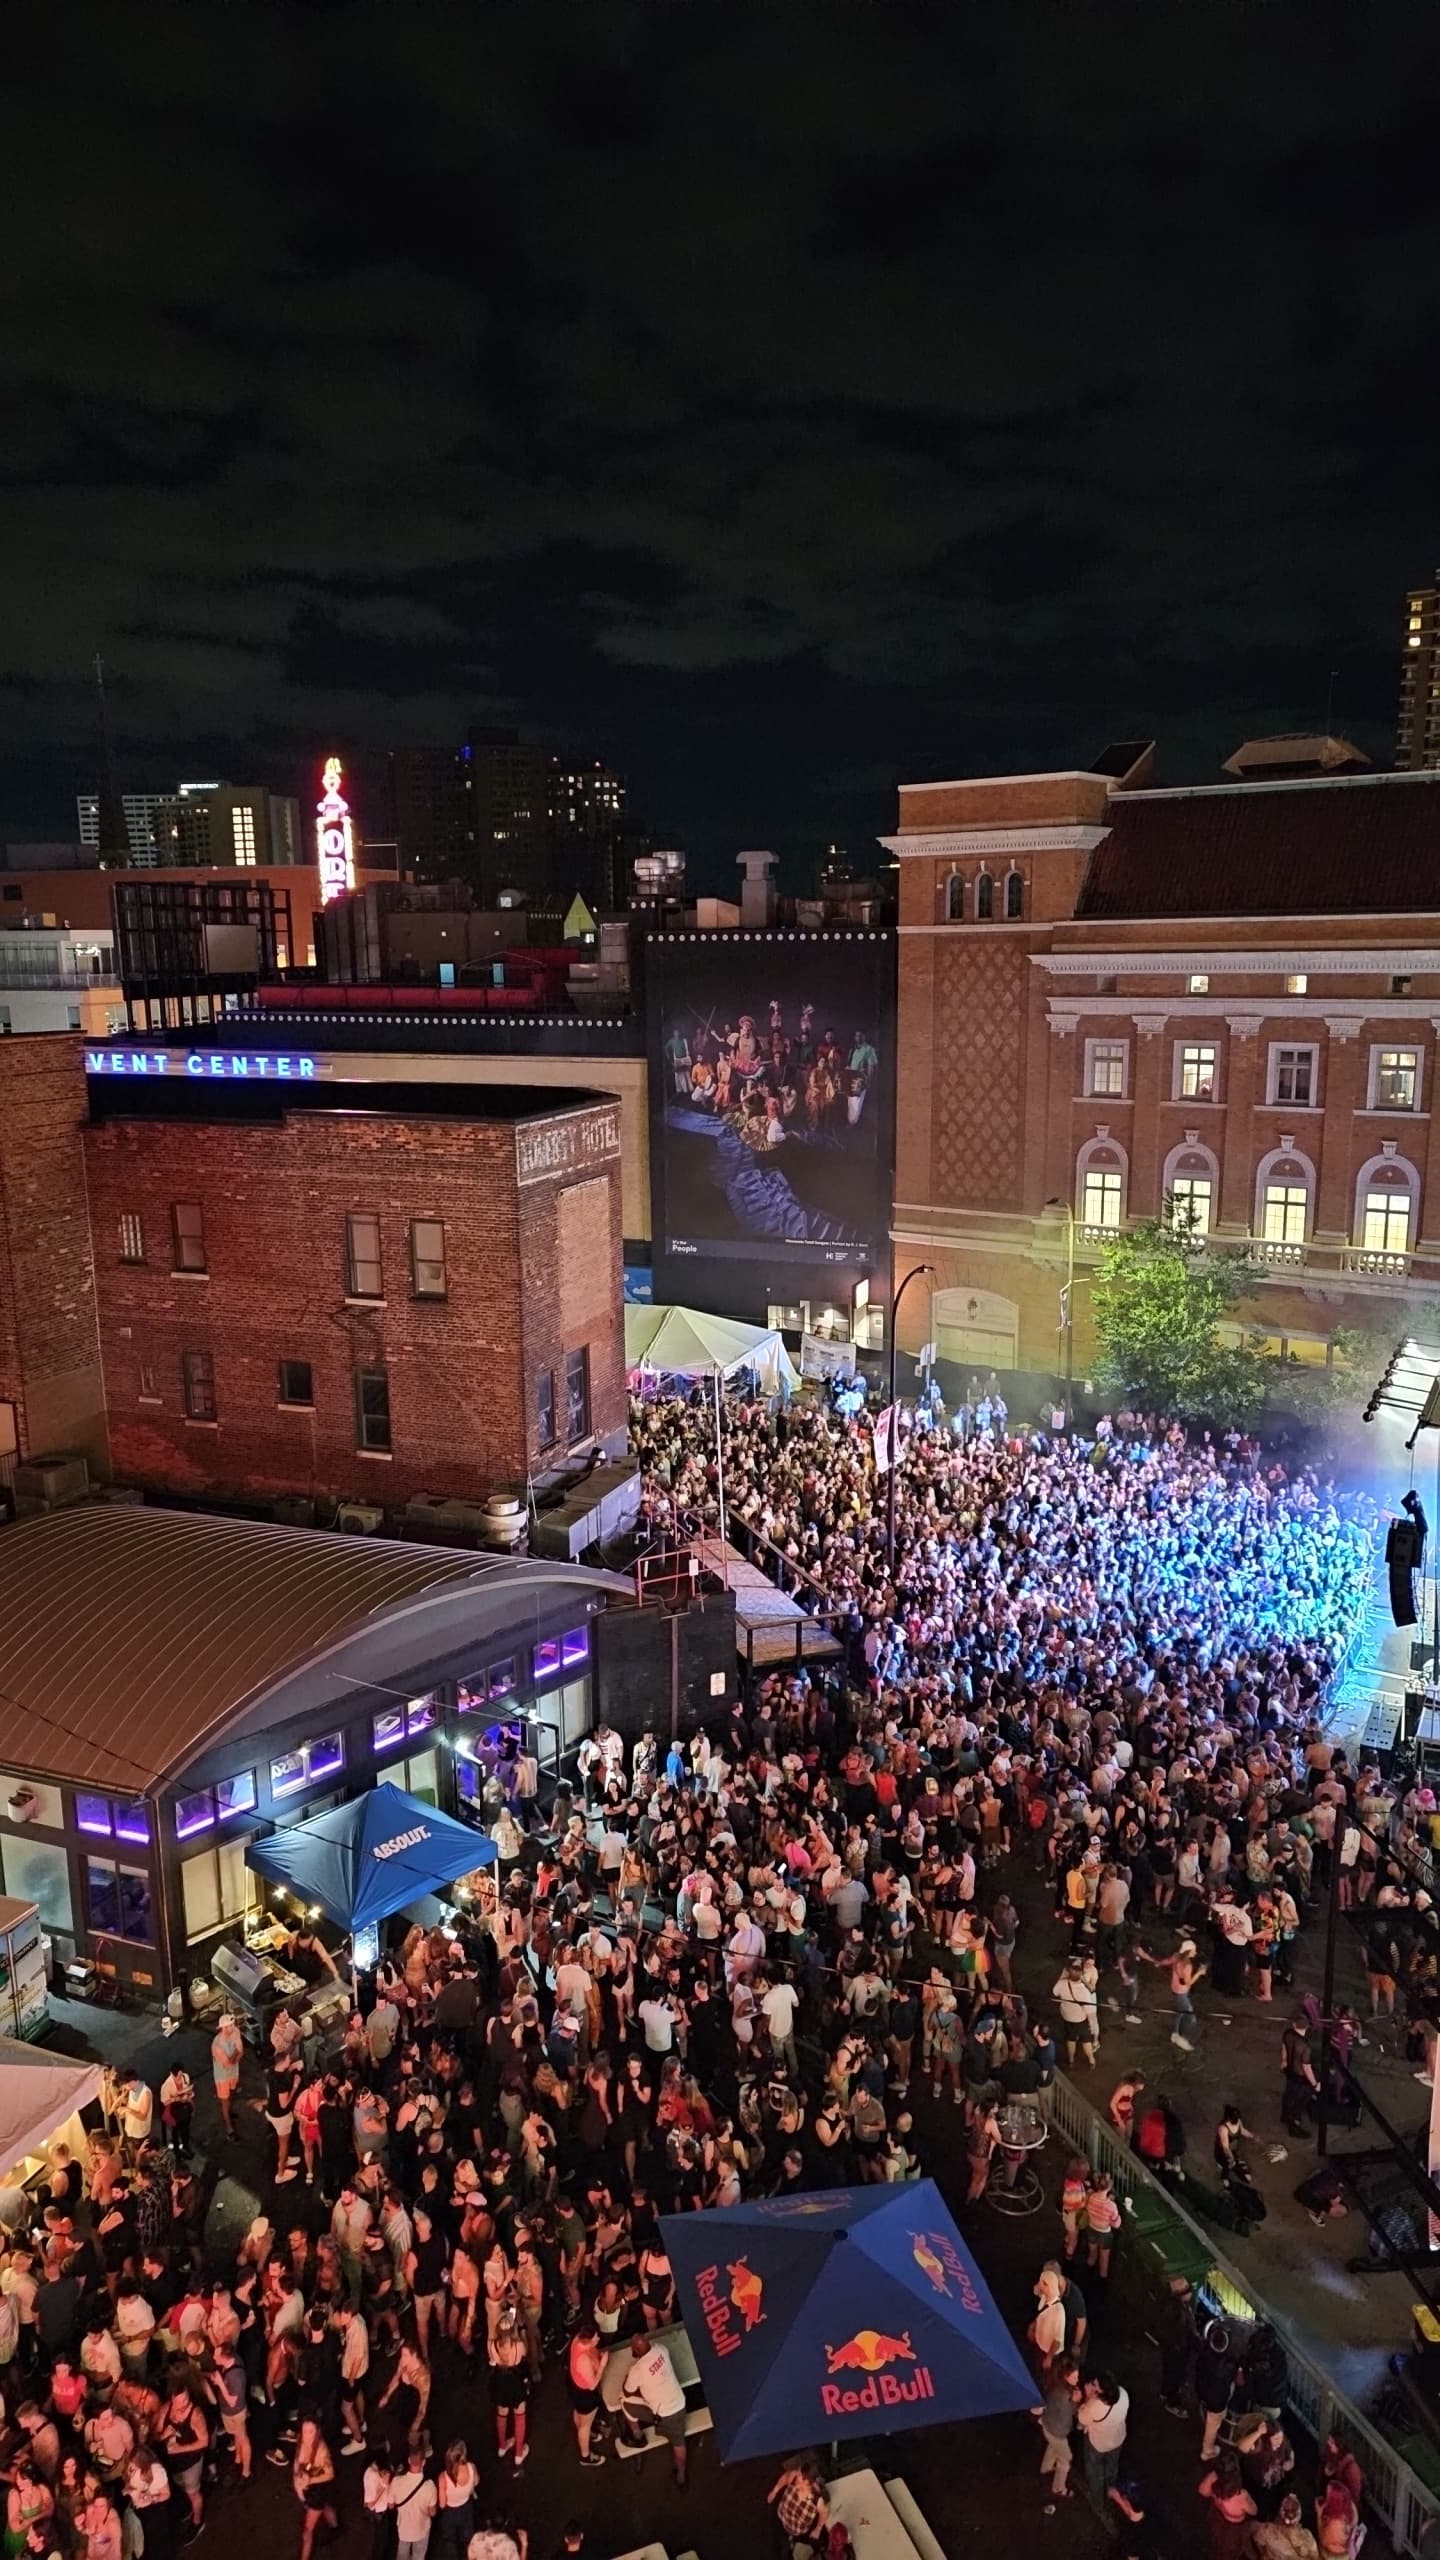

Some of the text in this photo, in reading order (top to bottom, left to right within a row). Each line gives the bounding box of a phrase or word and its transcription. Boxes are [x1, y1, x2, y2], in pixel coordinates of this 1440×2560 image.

[89, 1053, 314, 1077] VENT CENTER
[581, 1115, 619, 1153] HOTEL
[672, 1244, 698, 1254] People
[928, 2232, 984, 2314] Red Bull
[695, 2265, 742, 2357] Red Bull
[649, 2354, 665, 2376] STAFF
[821, 2367, 935, 2415] Red Bull
